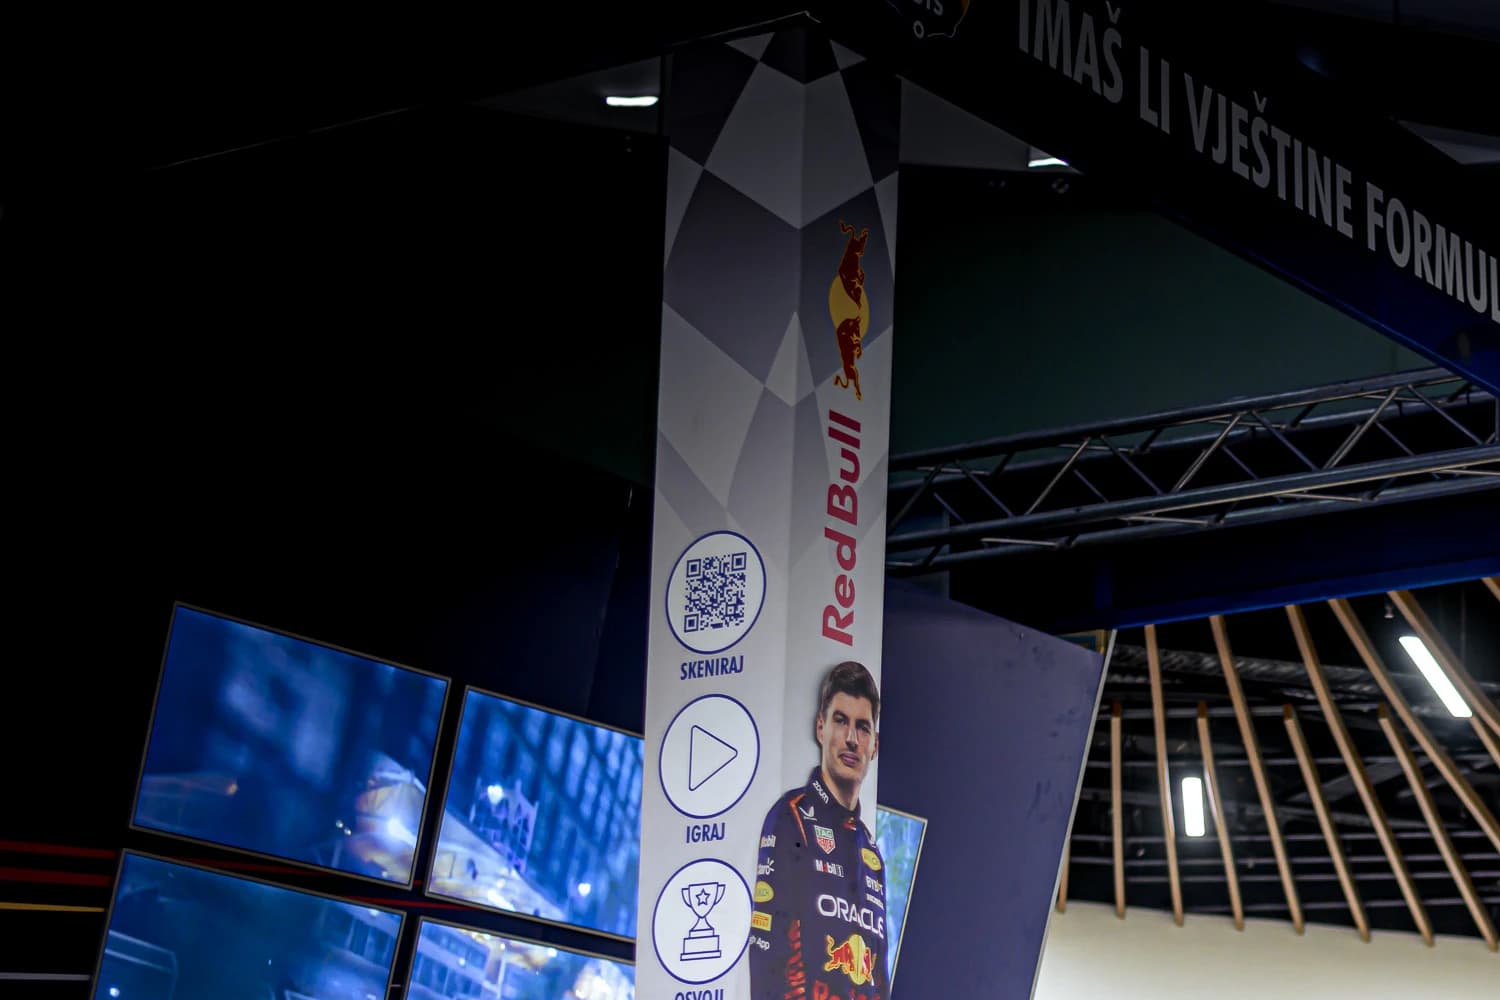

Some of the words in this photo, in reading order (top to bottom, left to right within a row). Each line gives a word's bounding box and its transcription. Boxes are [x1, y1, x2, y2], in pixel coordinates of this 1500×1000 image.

[1018, 0, 1123, 104] IMAŠ
[1139, 45, 1171, 135] LI
[1184, 71, 1353, 240] VJEŠTINE
[827, 409, 861, 526] Bull
[822, 527, 857, 647] Red
[680, 656, 744, 680] SKENIRAJ
[686, 823, 725, 843] IGRAJ
[818, 893, 885, 940] ORACLE
